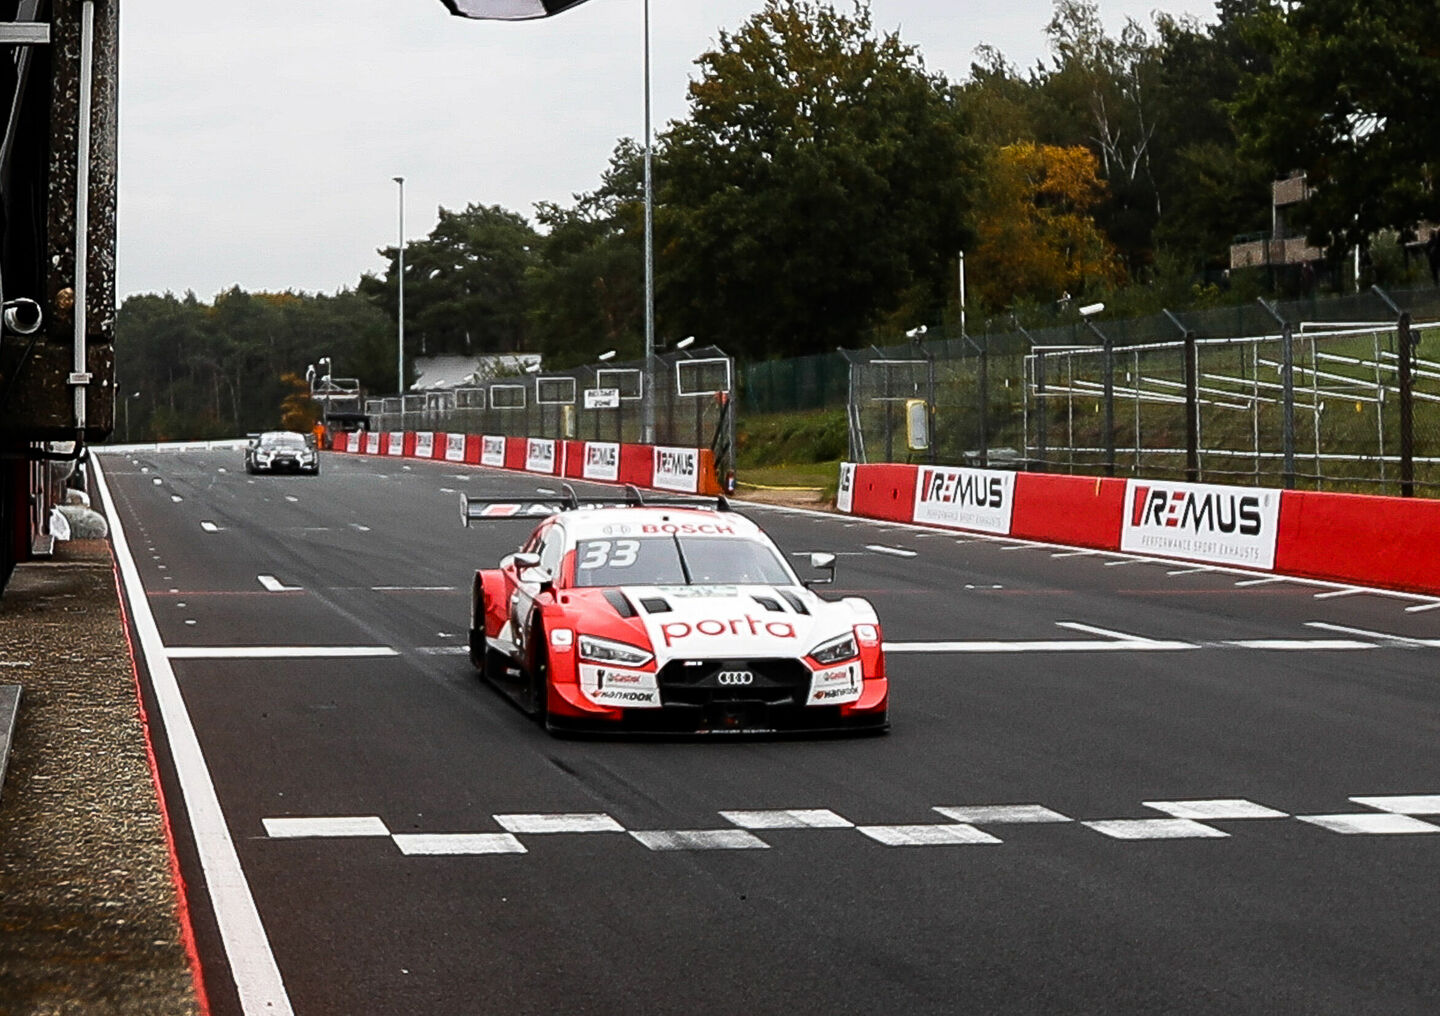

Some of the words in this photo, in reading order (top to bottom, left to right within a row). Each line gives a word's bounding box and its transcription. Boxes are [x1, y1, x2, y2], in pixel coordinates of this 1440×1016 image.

[660, 452, 693, 476] REMUS
[929, 472, 1003, 509] REMUS
[1143, 489, 1260, 536] REMUS
[641, 523, 735, 535] BOSCH
[580, 540, 641, 569] 33
[661, 614, 797, 647] porta
